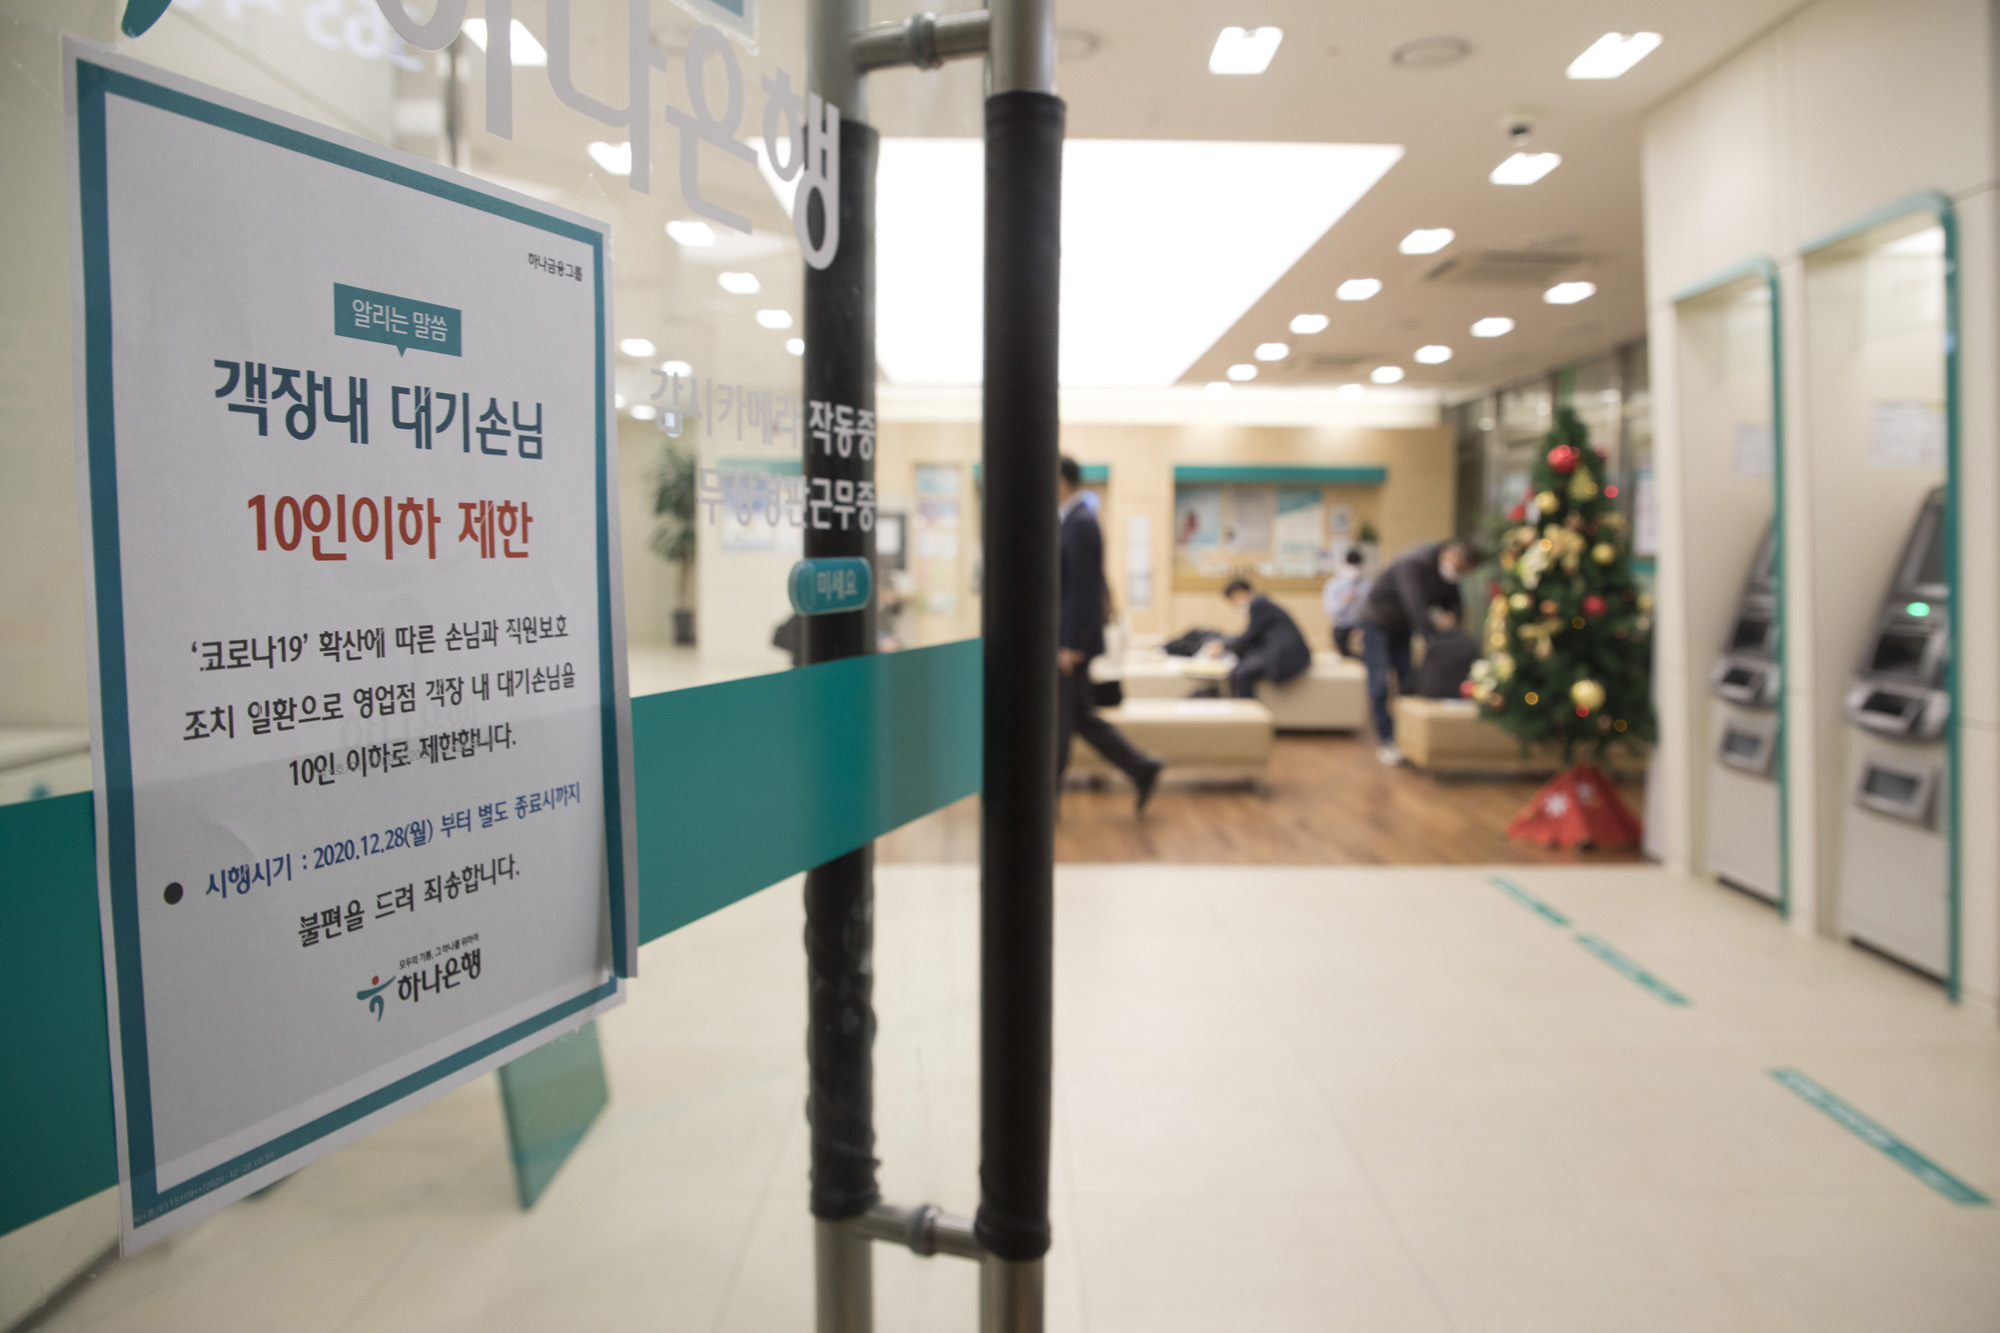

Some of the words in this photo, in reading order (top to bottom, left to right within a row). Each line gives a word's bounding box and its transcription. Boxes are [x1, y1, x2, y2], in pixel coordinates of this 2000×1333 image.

[528, 252, 583, 283] 하나금융그룹
[352, 299, 410, 336] 알리는
[413, 311, 449, 343] 말씀
[213, 359, 370, 445] 객장내
[391, 384, 543, 460] 대기손님
[650, 367, 802, 450] 감시카메라
[809, 400, 876, 461] 작동중
[247, 493, 442, 561] 10인이하
[457, 499, 534, 560] 제한
[817, 569, 858, 601] 미세요
[318, 626, 386, 663] 확산에
[395, 624, 437, 655] 따른
[445, 618, 499, 652] 손님과
[505, 614, 569, 645] 직원보호
[183, 704, 235, 741] 조치
[247, 692, 344, 736] 일환으로
[352, 681, 416, 719] 영업점
[425, 676, 465, 708] 객장
[471, 673, 490, 701] 내
[497, 661, 576, 698] 대기손님을
[289, 752, 336, 786] 10인
[346, 740, 411, 778] 이하로
[419, 722, 517, 764] 제한합니다.
[205, 853, 292, 899] 시행시기
[302, 854, 308, 871] :
[313, 818, 434, 870] 2020.12.28(월)
[440, 808, 472, 838] 부터
[477, 800, 509, 829] 별도
[514, 781, 581, 820] 종료시까지
[298, 899, 365, 948] 불편을
[375, 882, 414, 920] 드려
[423, 853, 520, 904] 죄송합니다.
[397, 948, 481, 1003] 하나은행
